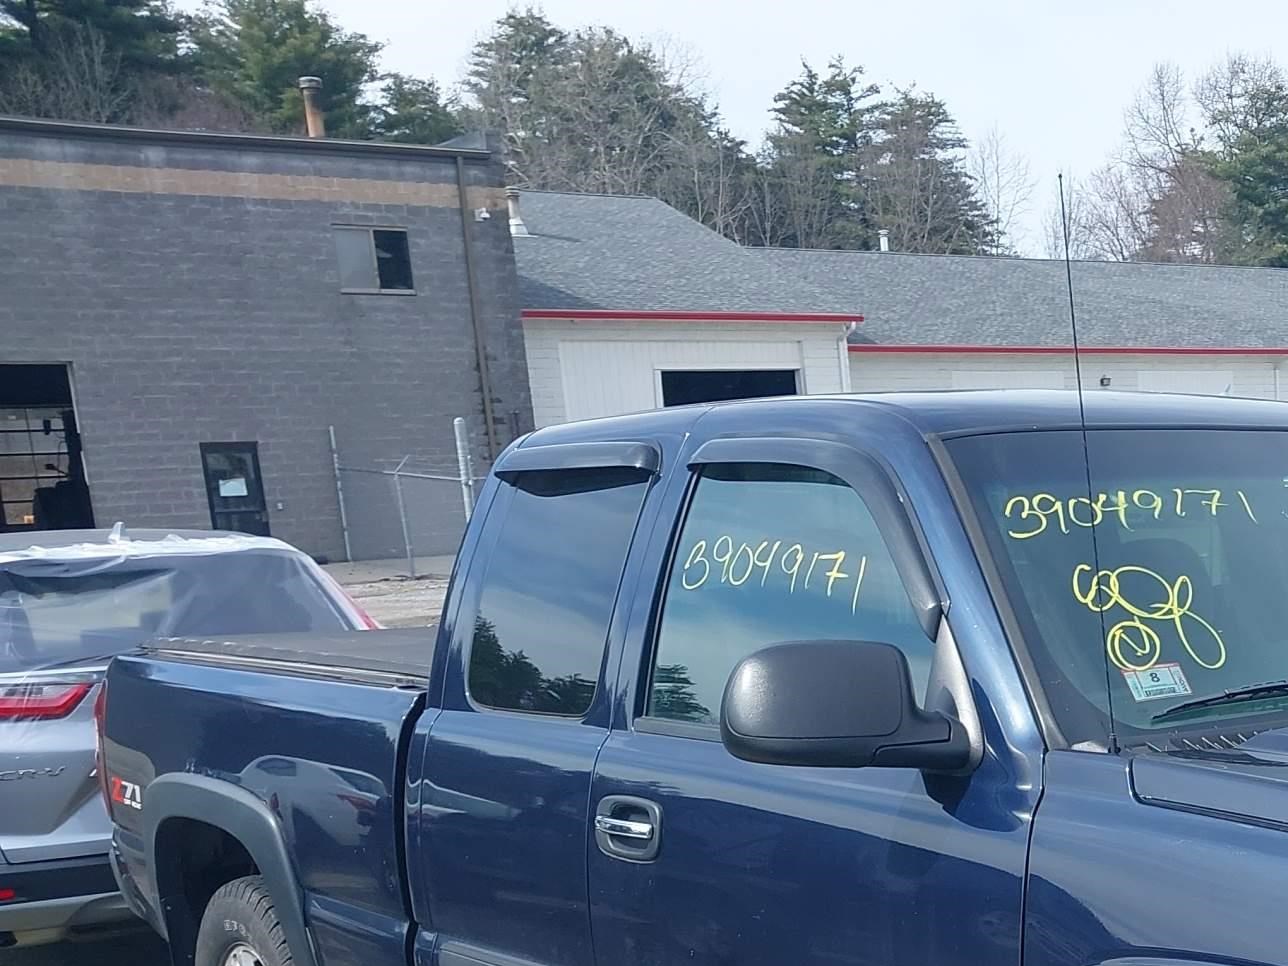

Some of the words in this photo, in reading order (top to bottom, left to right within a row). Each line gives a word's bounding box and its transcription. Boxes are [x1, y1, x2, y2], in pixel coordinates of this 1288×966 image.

[1004, 488, 1258, 539] 39049171
[682, 535, 867, 616] 39049171
[1149, 672, 1161, 683] 8
[111, 777, 142, 803] Z71
